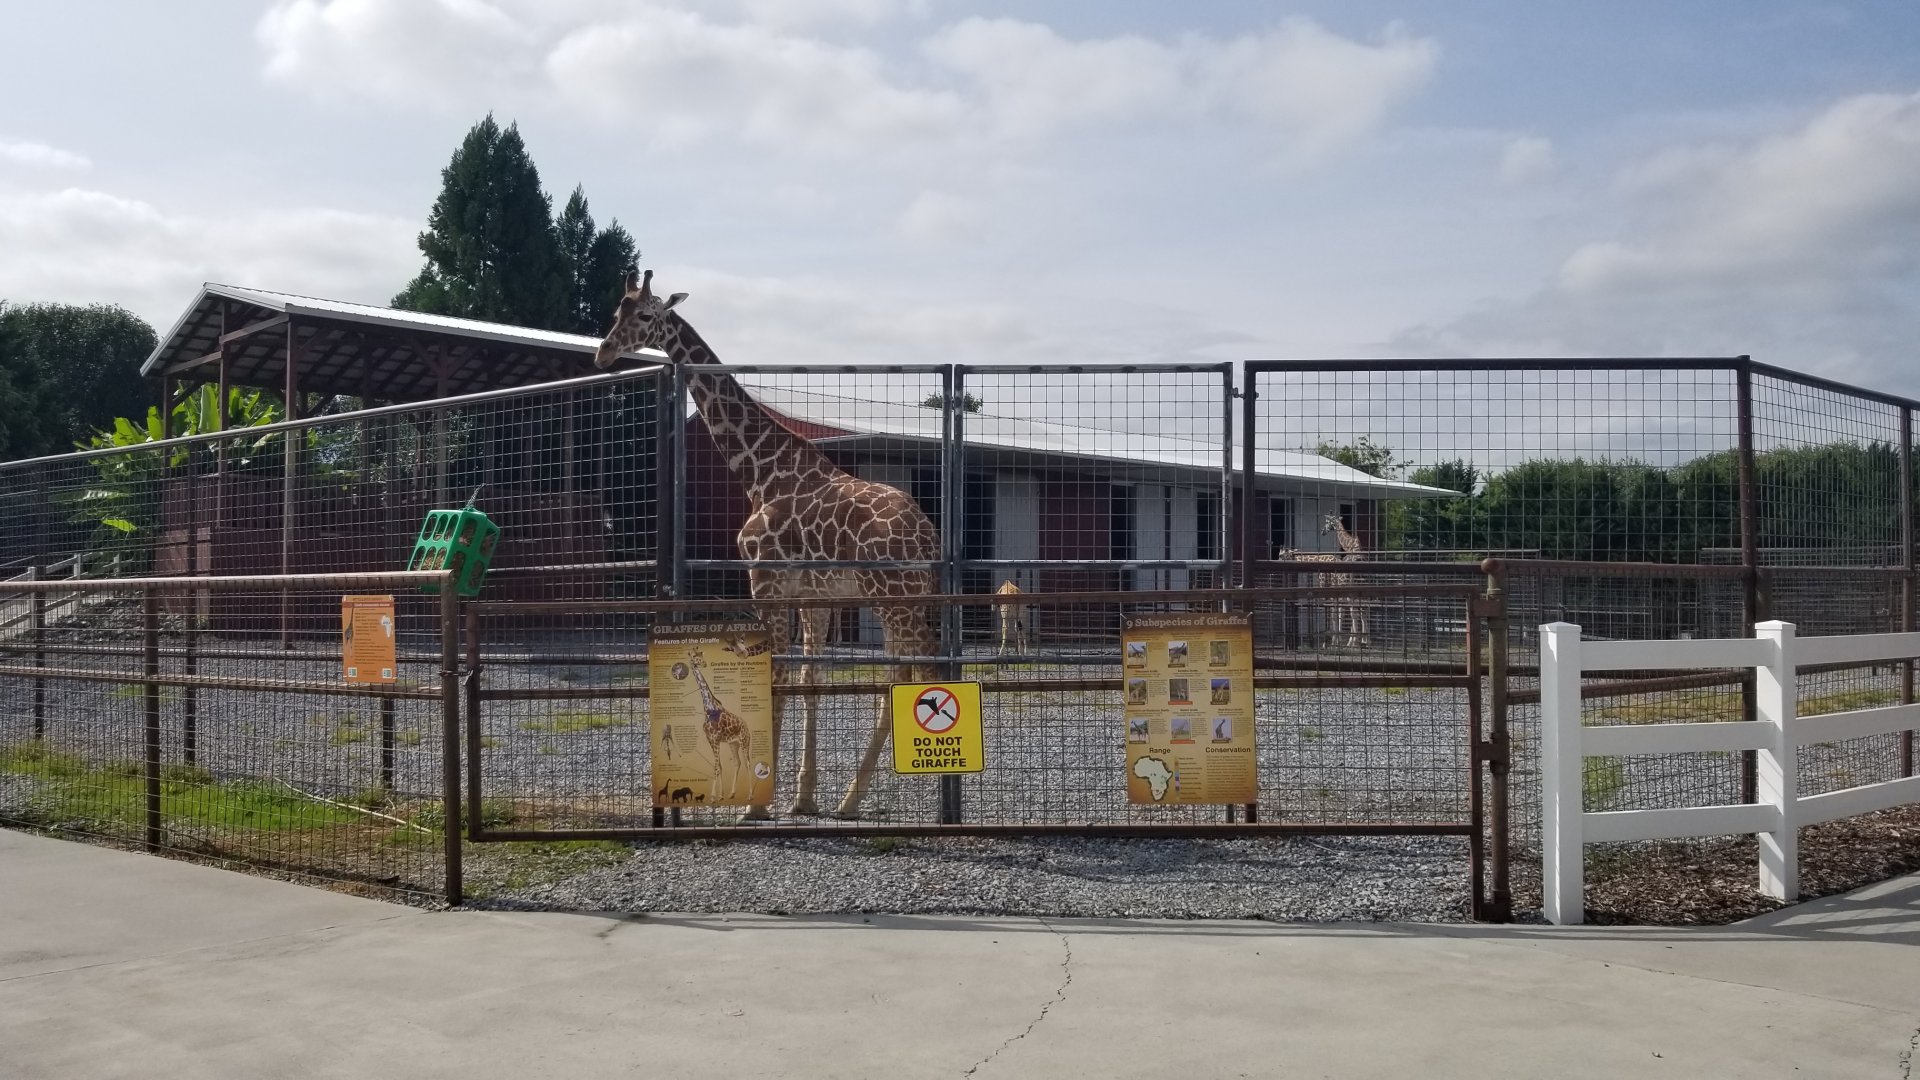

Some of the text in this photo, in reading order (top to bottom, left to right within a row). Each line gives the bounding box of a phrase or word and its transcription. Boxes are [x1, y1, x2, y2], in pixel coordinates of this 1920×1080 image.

[1127, 616, 1248, 628] 9 Subspecies of Giraffes
[654, 623, 766, 634] GIRAFFES OF AFRICA
[913, 737, 962, 746] DO NOT
[915, 747, 961, 757] TOUCH
[912, 758, 967, 768] GIRAFFE
